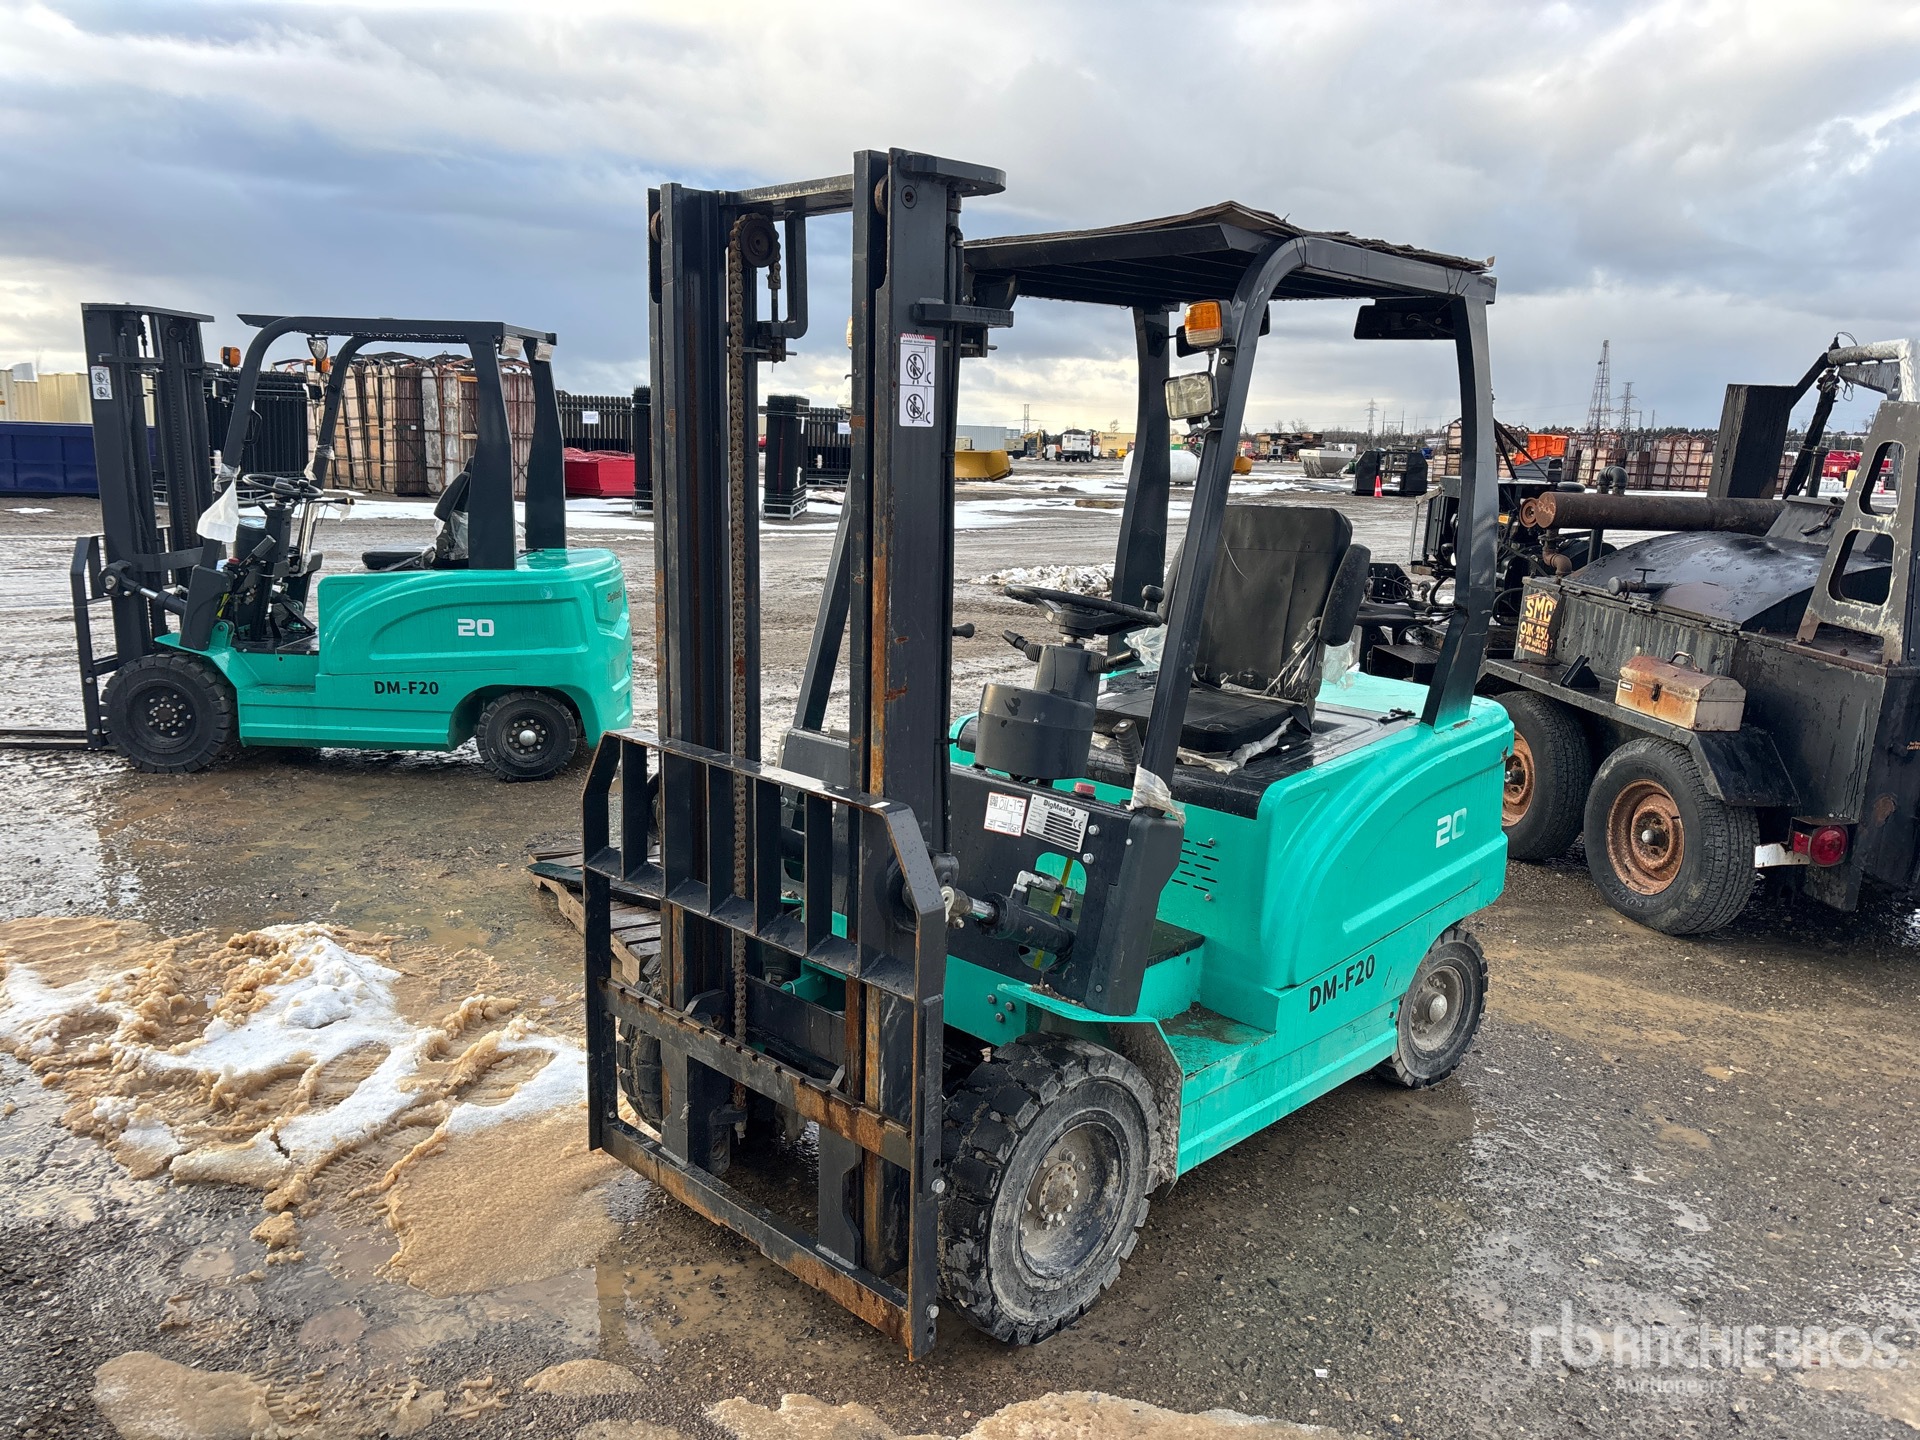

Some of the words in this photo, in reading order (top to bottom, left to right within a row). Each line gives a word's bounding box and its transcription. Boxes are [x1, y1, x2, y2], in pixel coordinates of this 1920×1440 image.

[1526, 596, 1552, 622] SMC
[457, 618, 494, 636] 20
[374, 681, 439, 695] DM-F20
[1435, 807, 1467, 848] 20
[1309, 954, 1375, 1013] DM-F20
